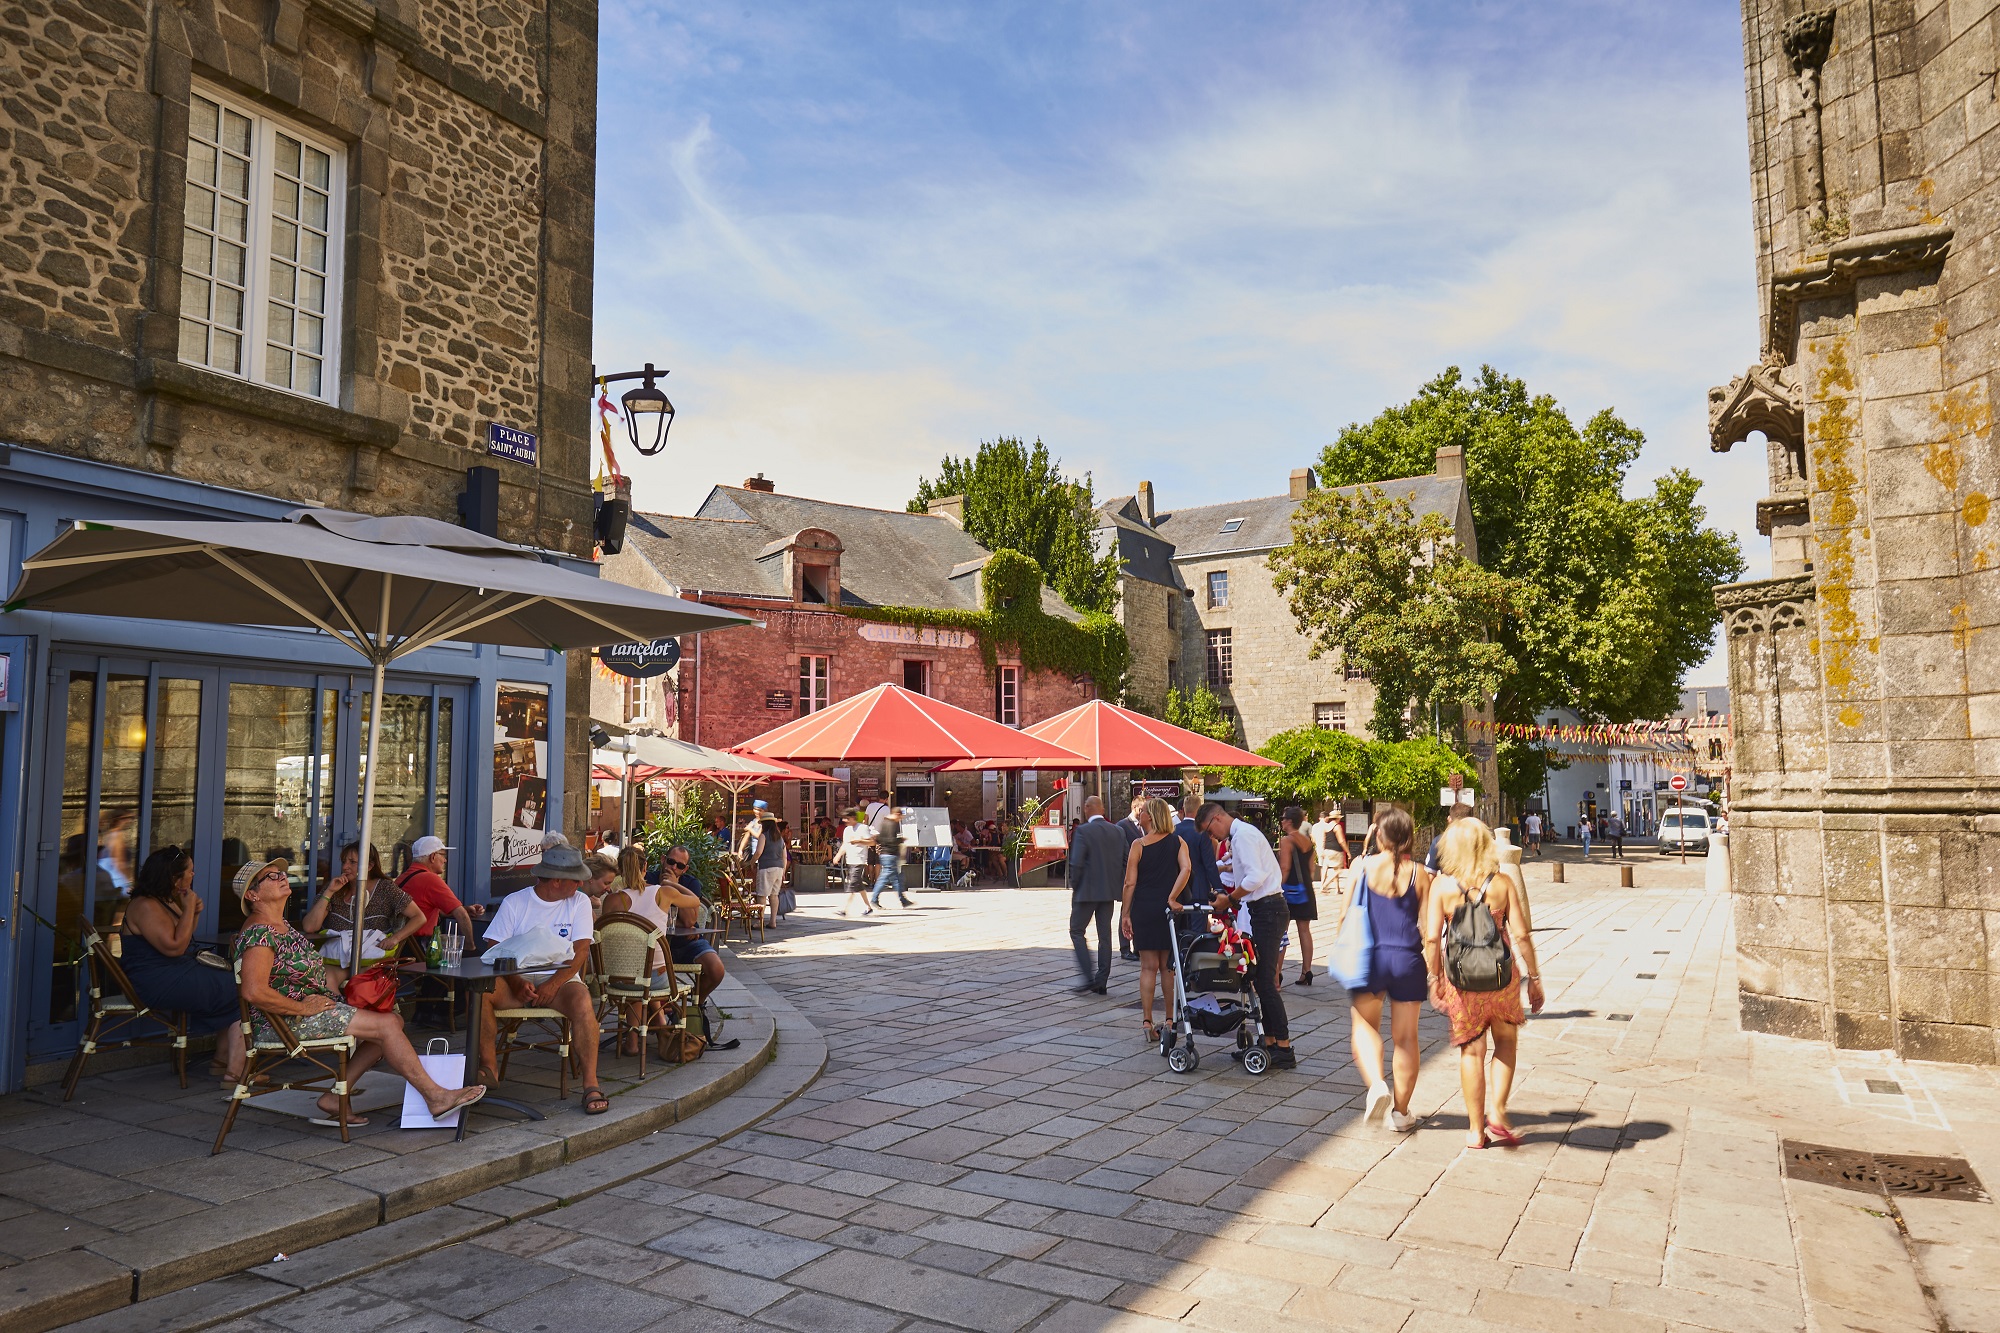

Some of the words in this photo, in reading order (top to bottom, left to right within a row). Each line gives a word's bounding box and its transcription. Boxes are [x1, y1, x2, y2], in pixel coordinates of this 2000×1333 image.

[500, 429, 530, 446] PLACE
[491, 440, 536, 461] SAINT-AUBIN
[510, 843, 542, 858] Lucien
[513, 839, 528, 848] Chez
